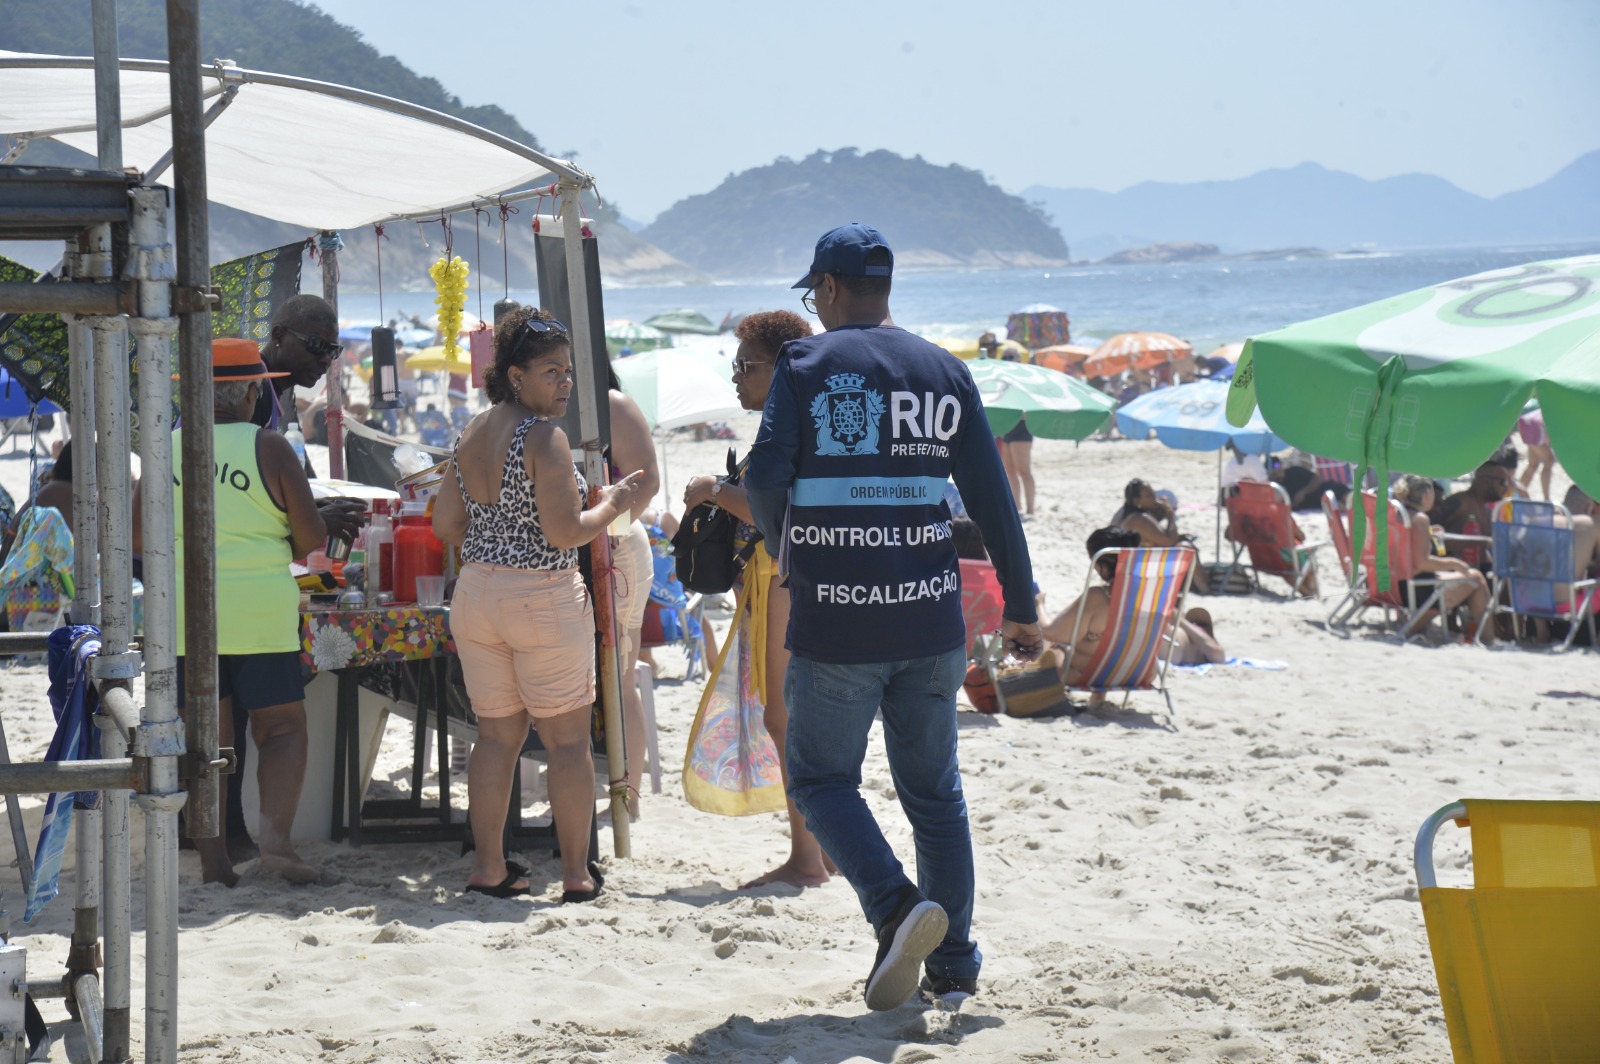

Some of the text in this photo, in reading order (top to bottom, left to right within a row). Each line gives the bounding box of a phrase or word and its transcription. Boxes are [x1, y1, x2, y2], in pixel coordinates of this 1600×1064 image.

[891, 391, 961, 441] RIO
[790, 525, 901, 546] CONTROLE
[817, 570, 957, 605] FISCALIZAÇÃO
